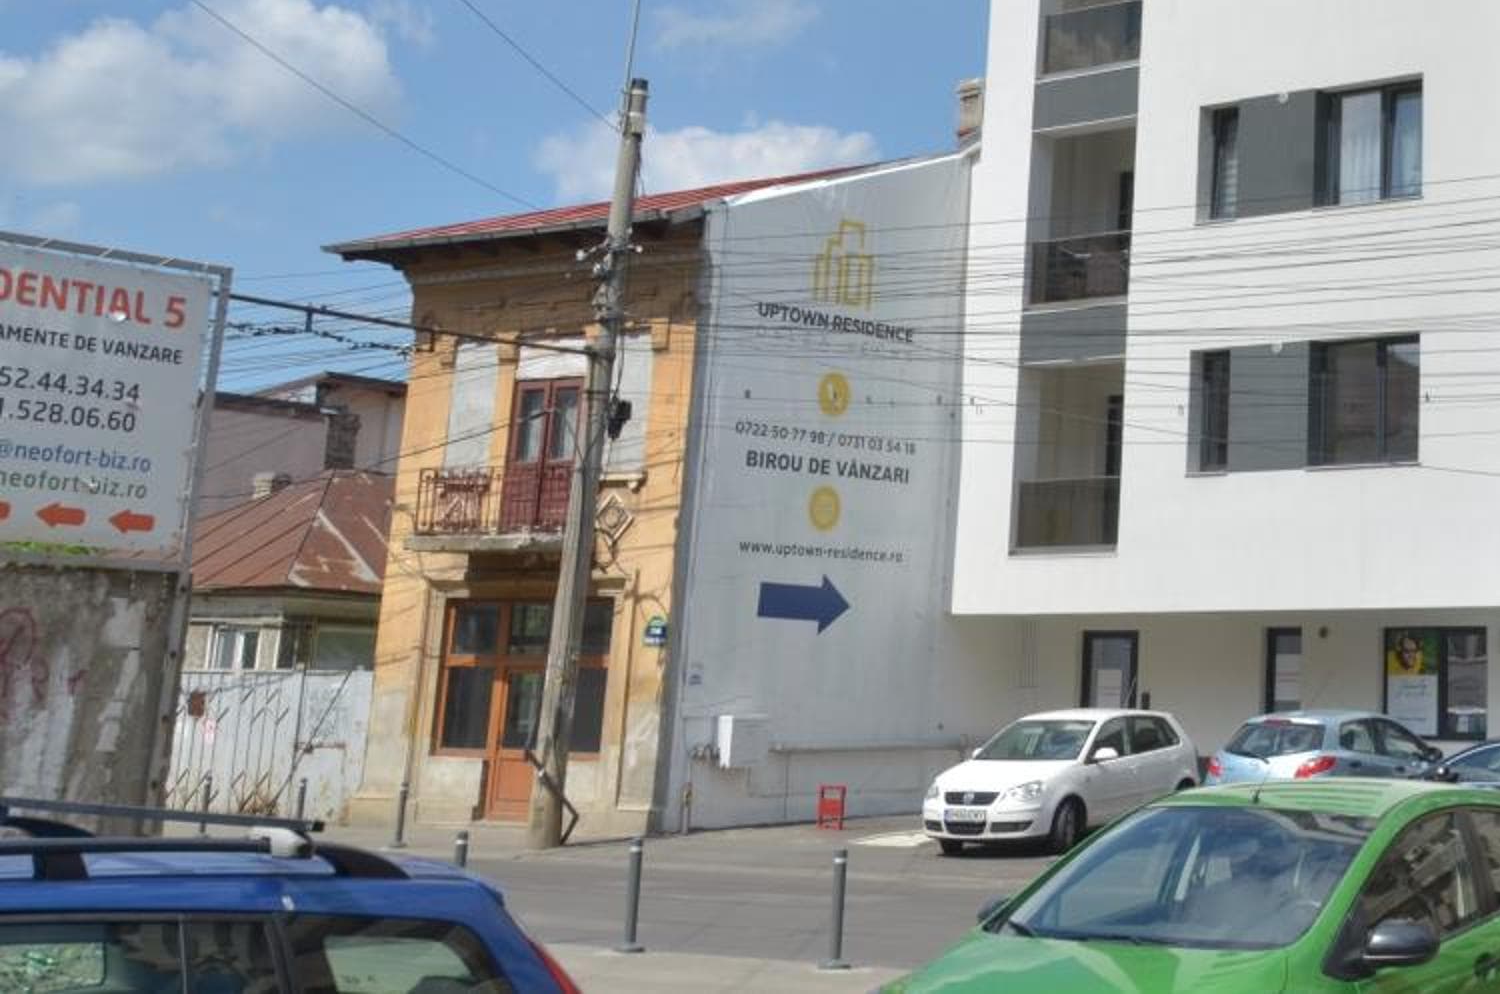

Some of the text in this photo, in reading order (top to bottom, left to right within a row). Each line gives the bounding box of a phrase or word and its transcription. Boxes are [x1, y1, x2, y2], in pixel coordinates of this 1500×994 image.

[164, 296, 187, 328] 5
[758, 302, 829, 328] UPTOWN
[832, 315, 914, 343] RESIDENCE
[74, 335, 97, 352] DE
[103, 338, 183, 365] VANZARE
[0, 366, 140, 402] 52.44.34.34
[746, 450, 803, 473] BIROU
[809, 457, 831, 475] DE
